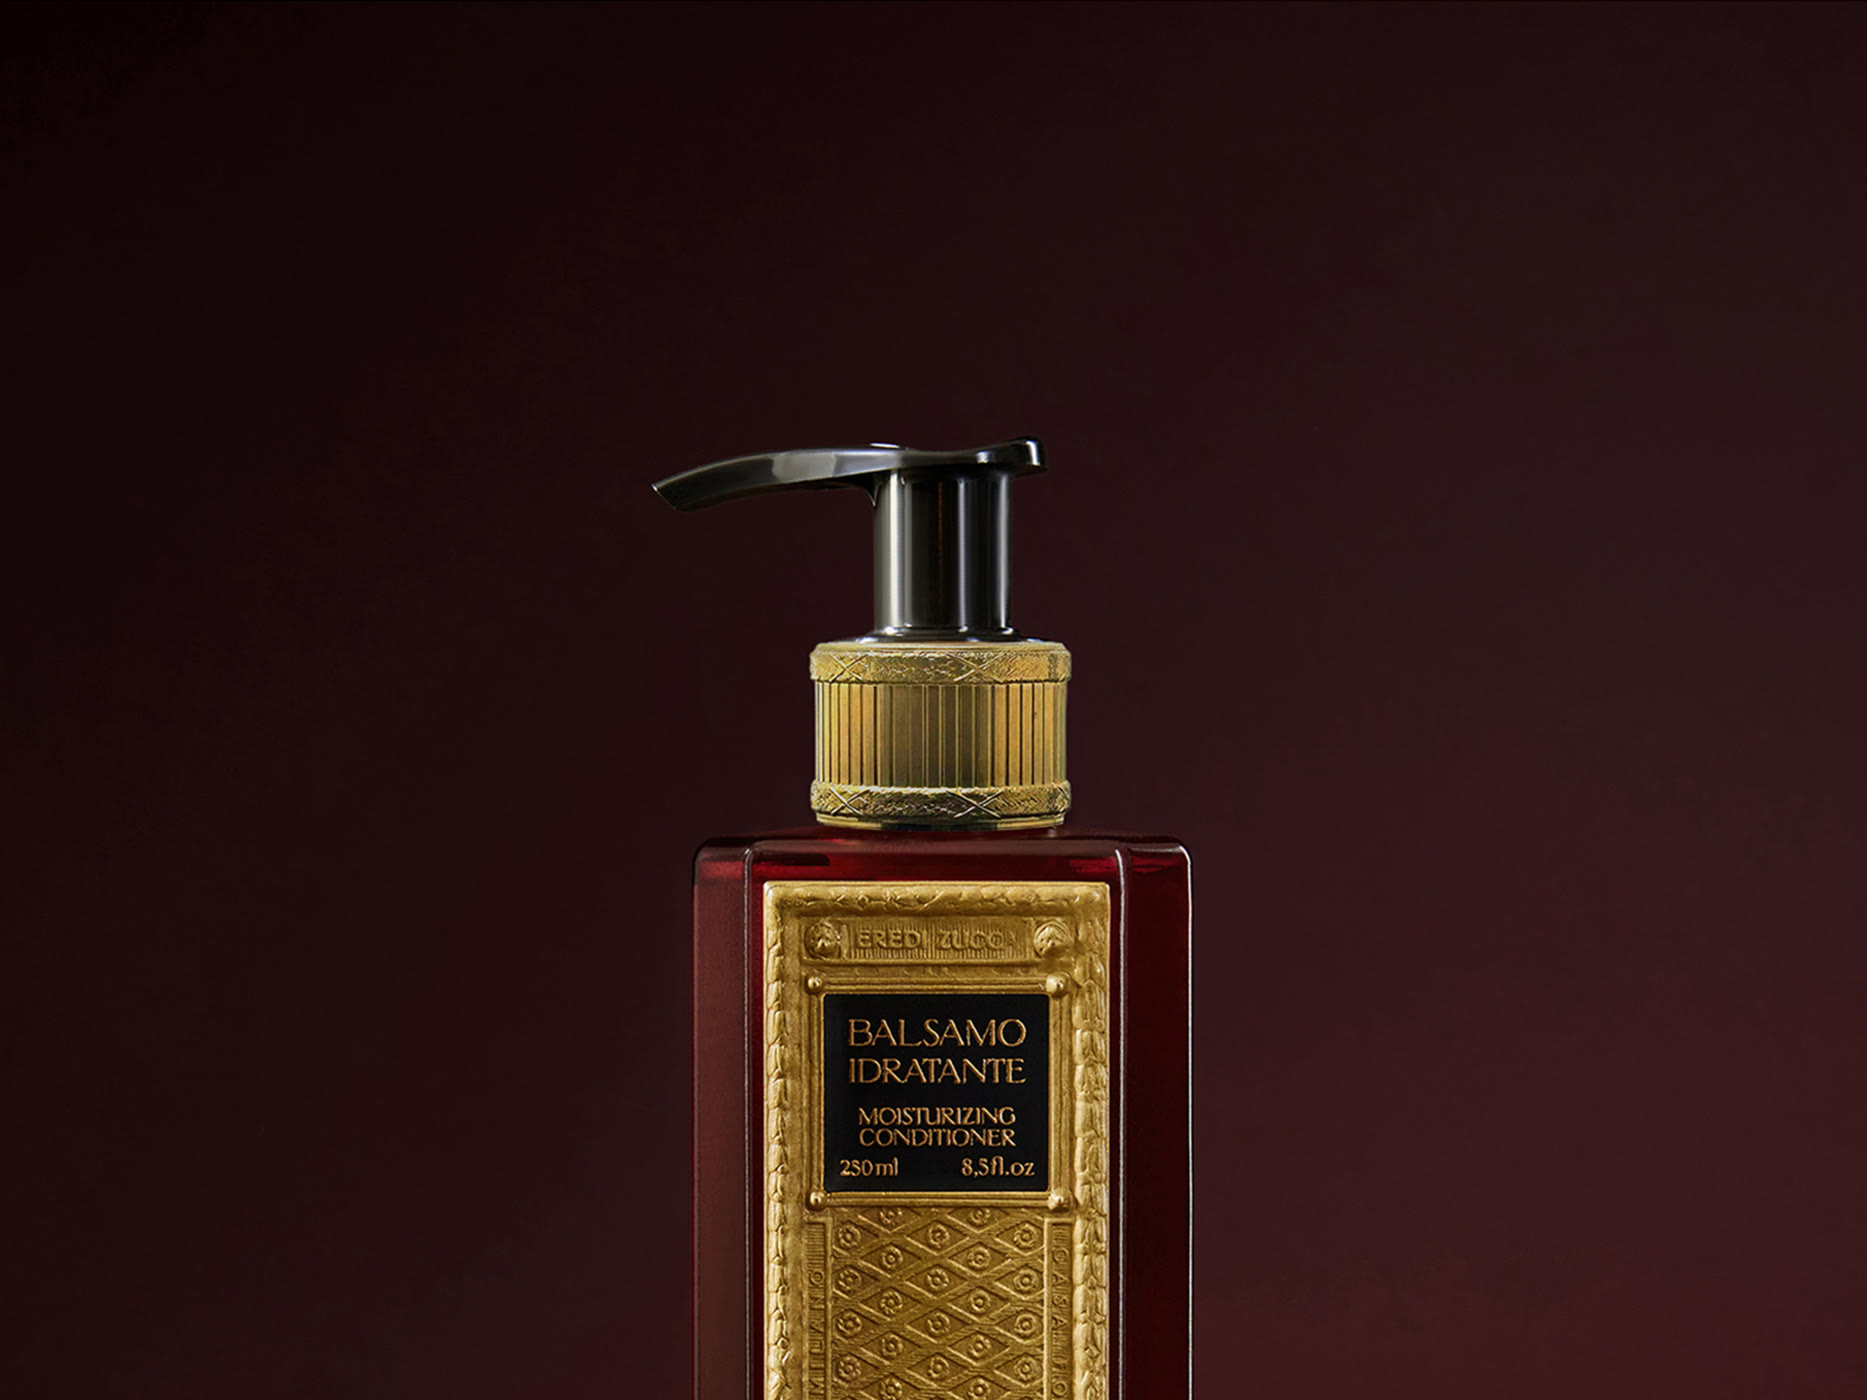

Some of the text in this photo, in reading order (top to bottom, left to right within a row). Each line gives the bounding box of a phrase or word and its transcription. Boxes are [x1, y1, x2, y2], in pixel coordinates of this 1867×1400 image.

[856, 928, 927, 949] EREDI
[847, 1018, 1027, 1047] BALSAMO
[848, 1058, 1027, 1084] IDRATANTE
[858, 1106, 1016, 1125] MOISTURIZING
[858, 1128, 1017, 1147] CONDITIONER
[1052, 1248, 1070, 1331] CASA
